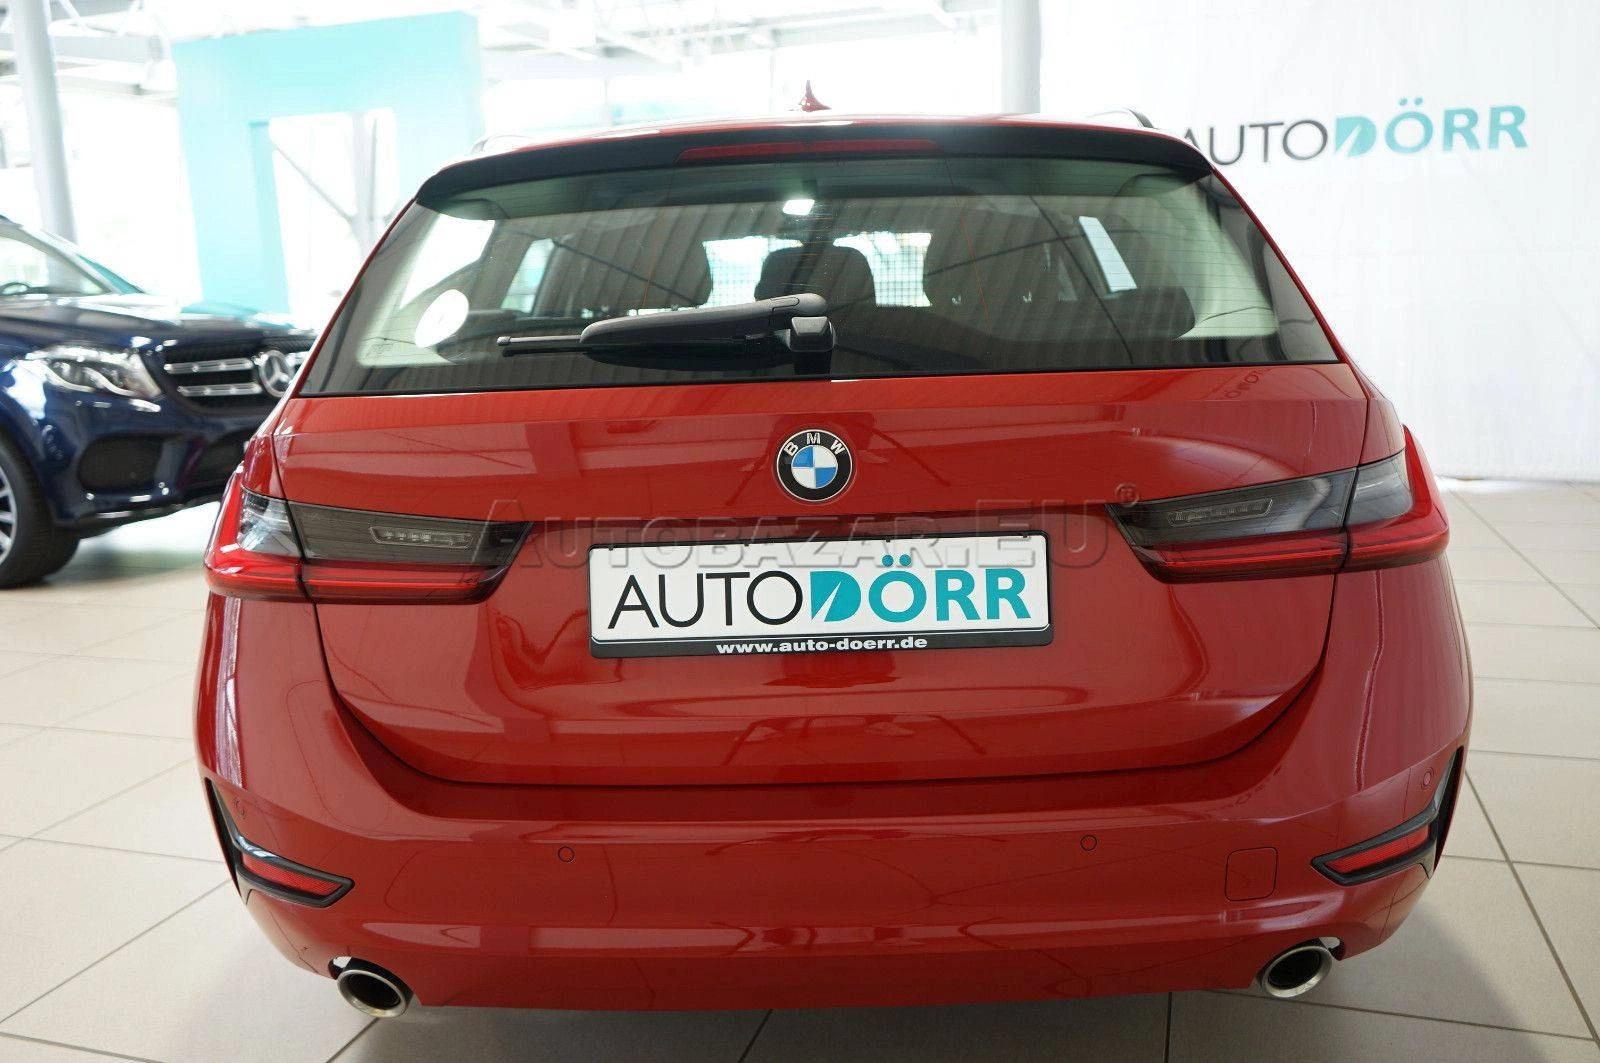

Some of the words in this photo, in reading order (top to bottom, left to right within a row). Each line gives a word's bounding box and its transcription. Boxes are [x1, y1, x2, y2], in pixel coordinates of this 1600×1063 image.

[783, 432, 846, 456] BMW
[608, 554, 1032, 629] AUTODÖRR
[716, 636, 928, 654] www.auto-doerr.de
